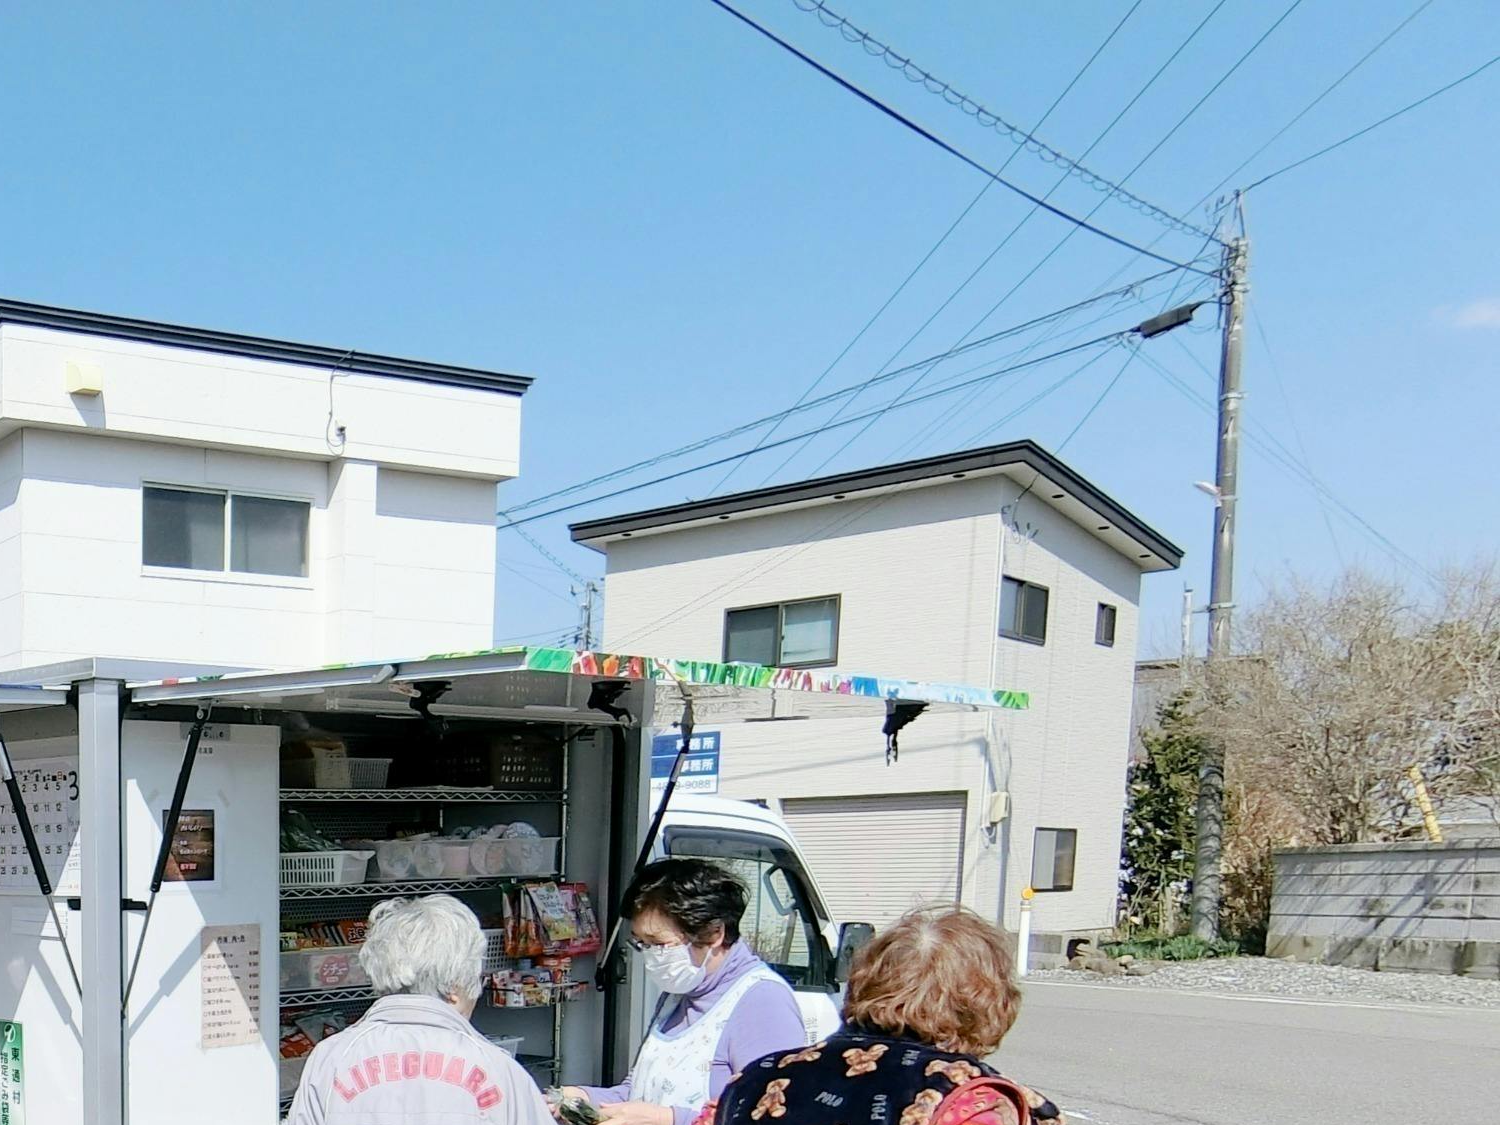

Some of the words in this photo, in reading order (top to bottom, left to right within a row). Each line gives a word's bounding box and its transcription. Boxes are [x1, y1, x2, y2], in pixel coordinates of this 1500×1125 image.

[21, 784, 27, 793] 2
[32, 783, 38, 792] 3
[44, 782, 49, 791] 4
[56, 782, 61, 791] 5
[68, 770, 79, 801] 3
[0, 805, 5, 815] 7
[11, 1047, 21, 1105] 東通村
[333, 1051, 502, 1110] LIFEGUARD
[815, 1091, 844, 1108] POLO
[871, 1094, 887, 1121] POLO
